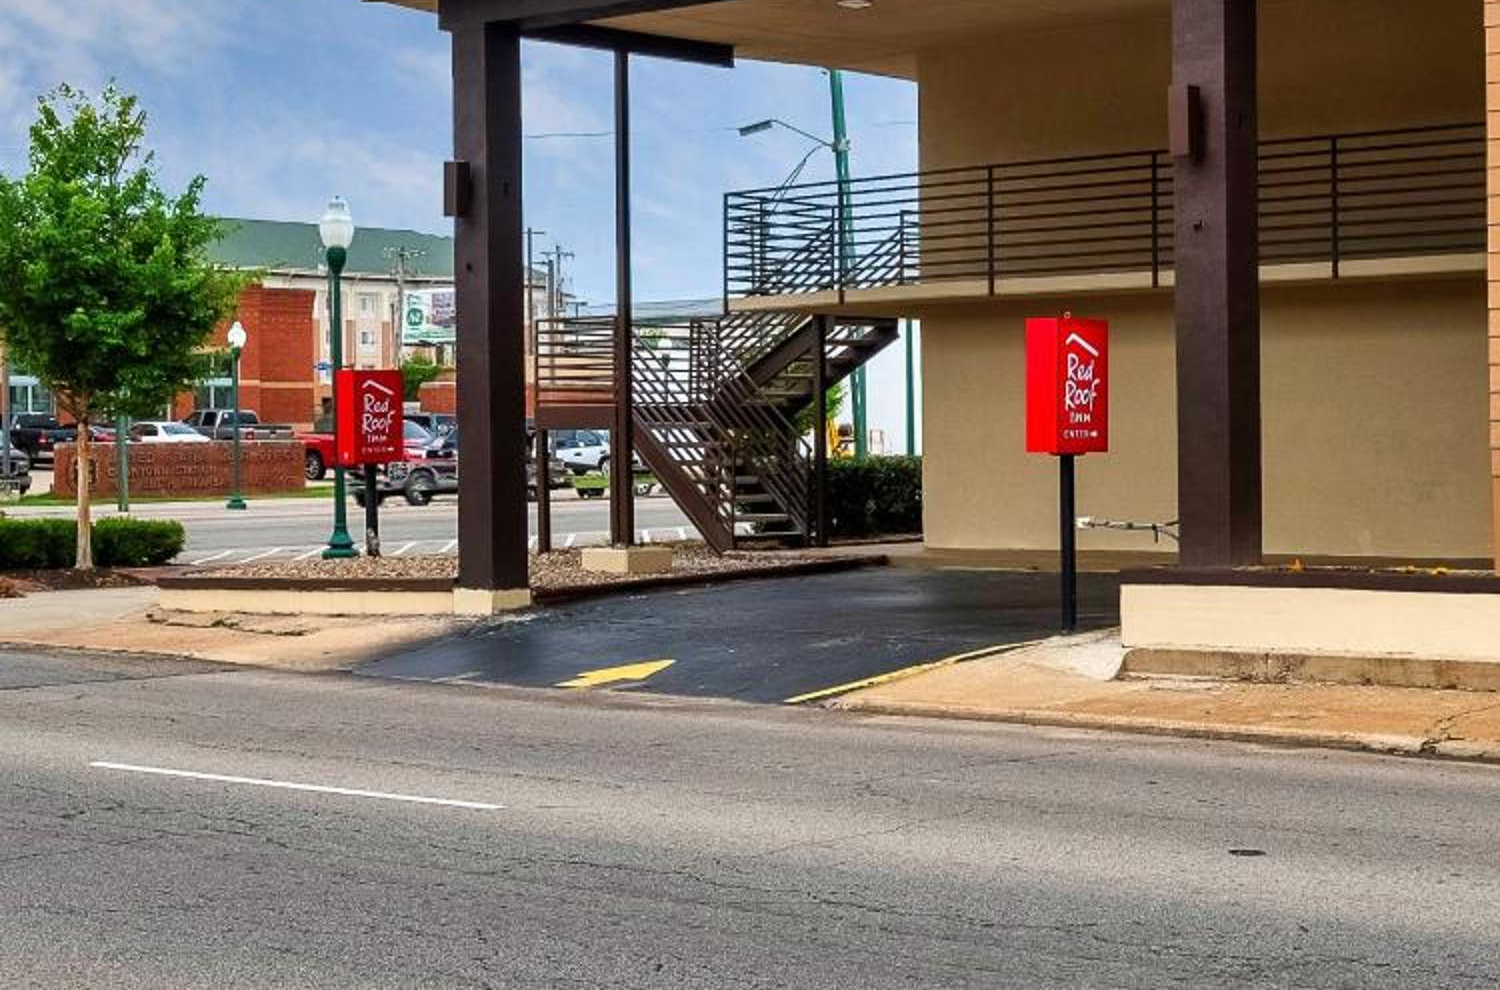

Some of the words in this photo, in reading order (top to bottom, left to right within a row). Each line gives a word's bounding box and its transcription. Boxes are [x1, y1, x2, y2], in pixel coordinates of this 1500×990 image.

[1067, 353, 1095, 381] Red
[363, 393, 390, 413] Red
[1064, 378, 1100, 411] Roof
[362, 410, 396, 434] Roof
